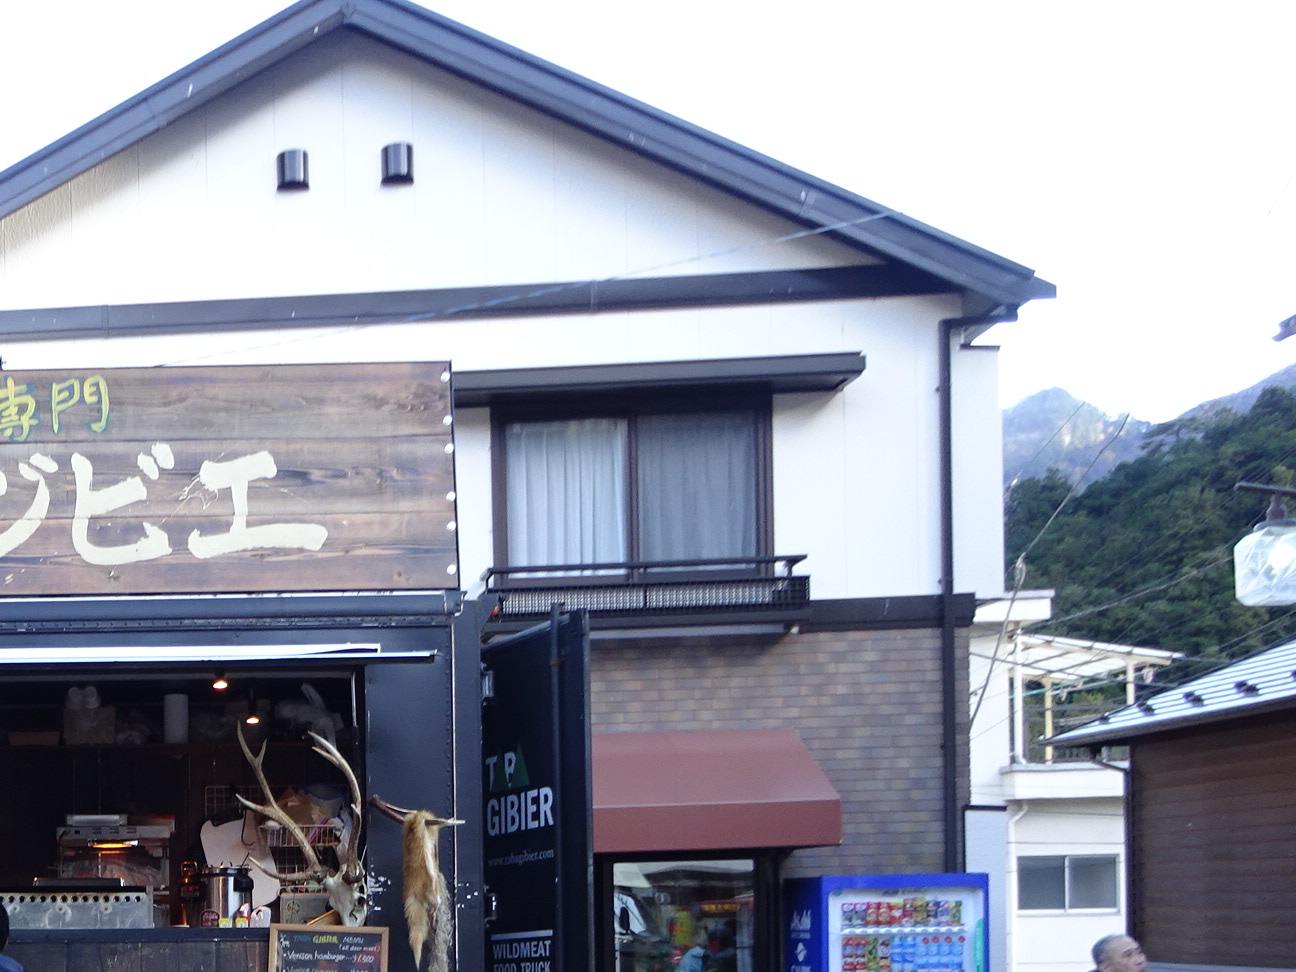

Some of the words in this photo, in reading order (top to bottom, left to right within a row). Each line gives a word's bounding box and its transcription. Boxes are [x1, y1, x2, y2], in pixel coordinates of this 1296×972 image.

[487, 786, 554, 837] GIBIER
[287, 951, 313, 960] Venison
[314, 950, 345, 962] hamburger
[493, 941, 551, 959] WILDMEAT
